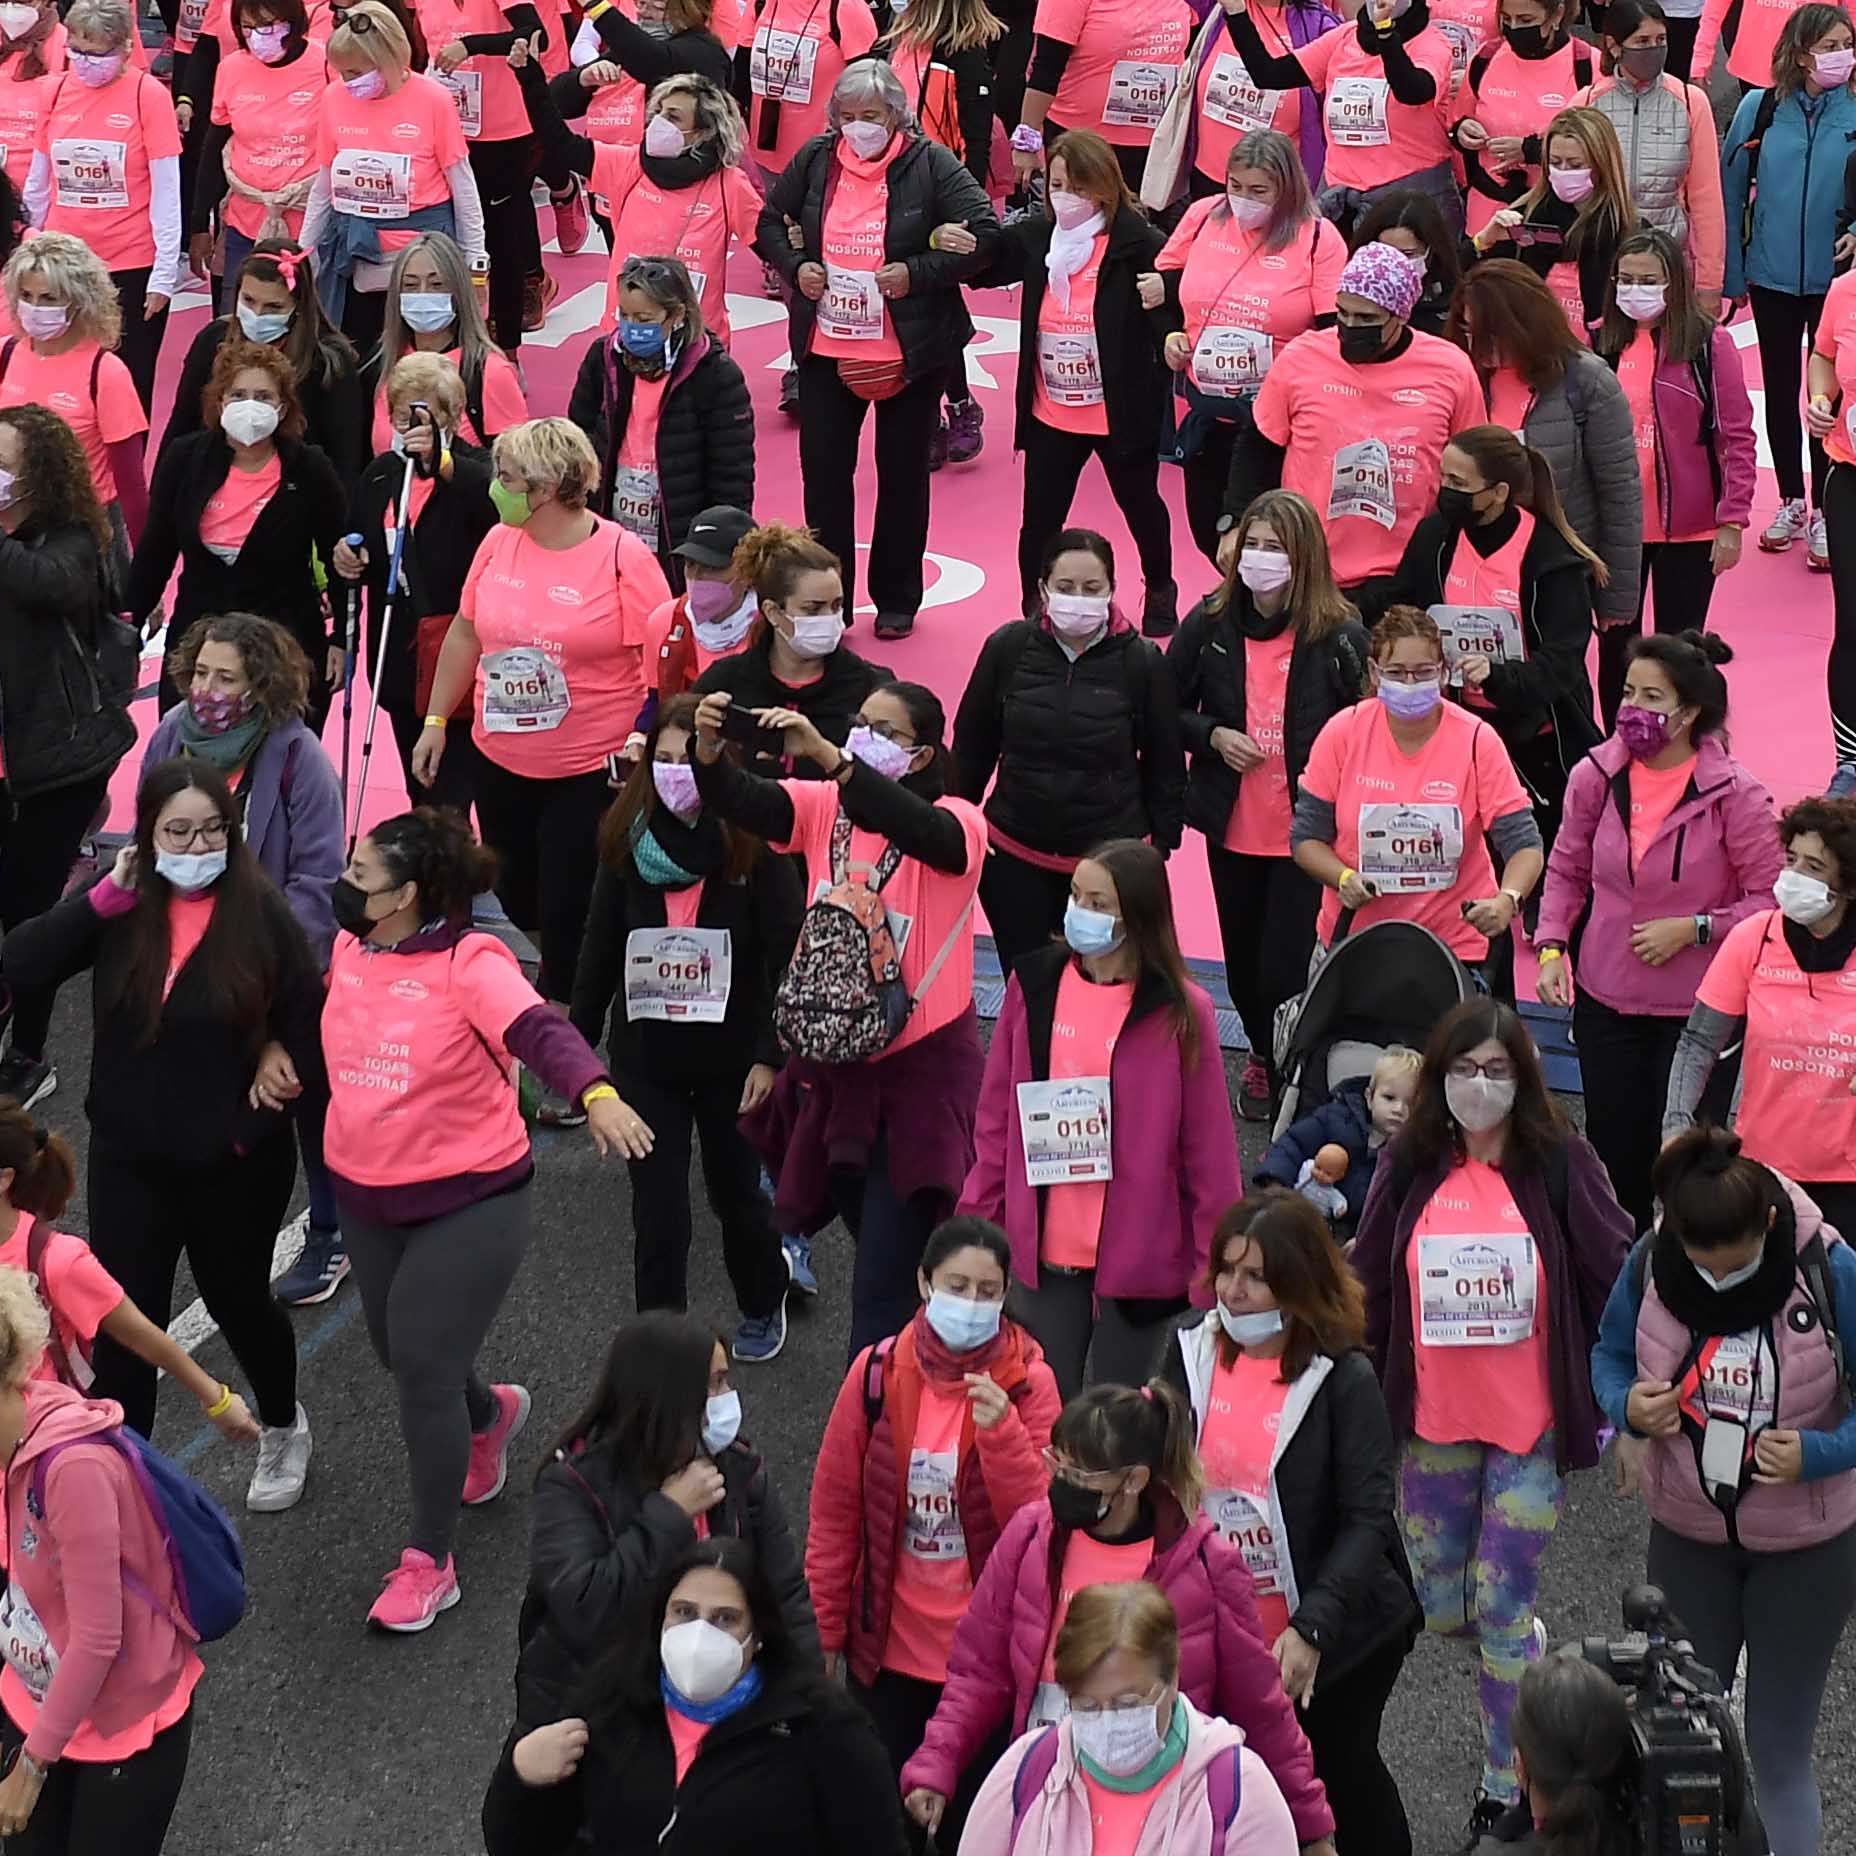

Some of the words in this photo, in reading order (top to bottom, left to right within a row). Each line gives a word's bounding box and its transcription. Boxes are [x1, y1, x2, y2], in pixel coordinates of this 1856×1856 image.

[1130, 87, 1159, 102] 016
[73, 165, 102, 179] 016
[354, 176, 385, 190] 016
[827, 244, 884, 257] NOSOTRA
[830, 293, 860, 311] 016
[1057, 360, 1087, 376] 016
[1216, 356, 1248, 369] 016
[1355, 468, 1386, 488] 016
[618, 497, 649, 517] 016
[1458, 637, 1495, 653] 016
[504, 680, 538, 696] 016
[1392, 837, 1432, 855] 016
[658, 963, 699, 981] 016
[1058, 1118, 1100, 1138] 016
[1455, 1278, 1501, 1297] 016
[1229, 1526, 1273, 1549] 016
